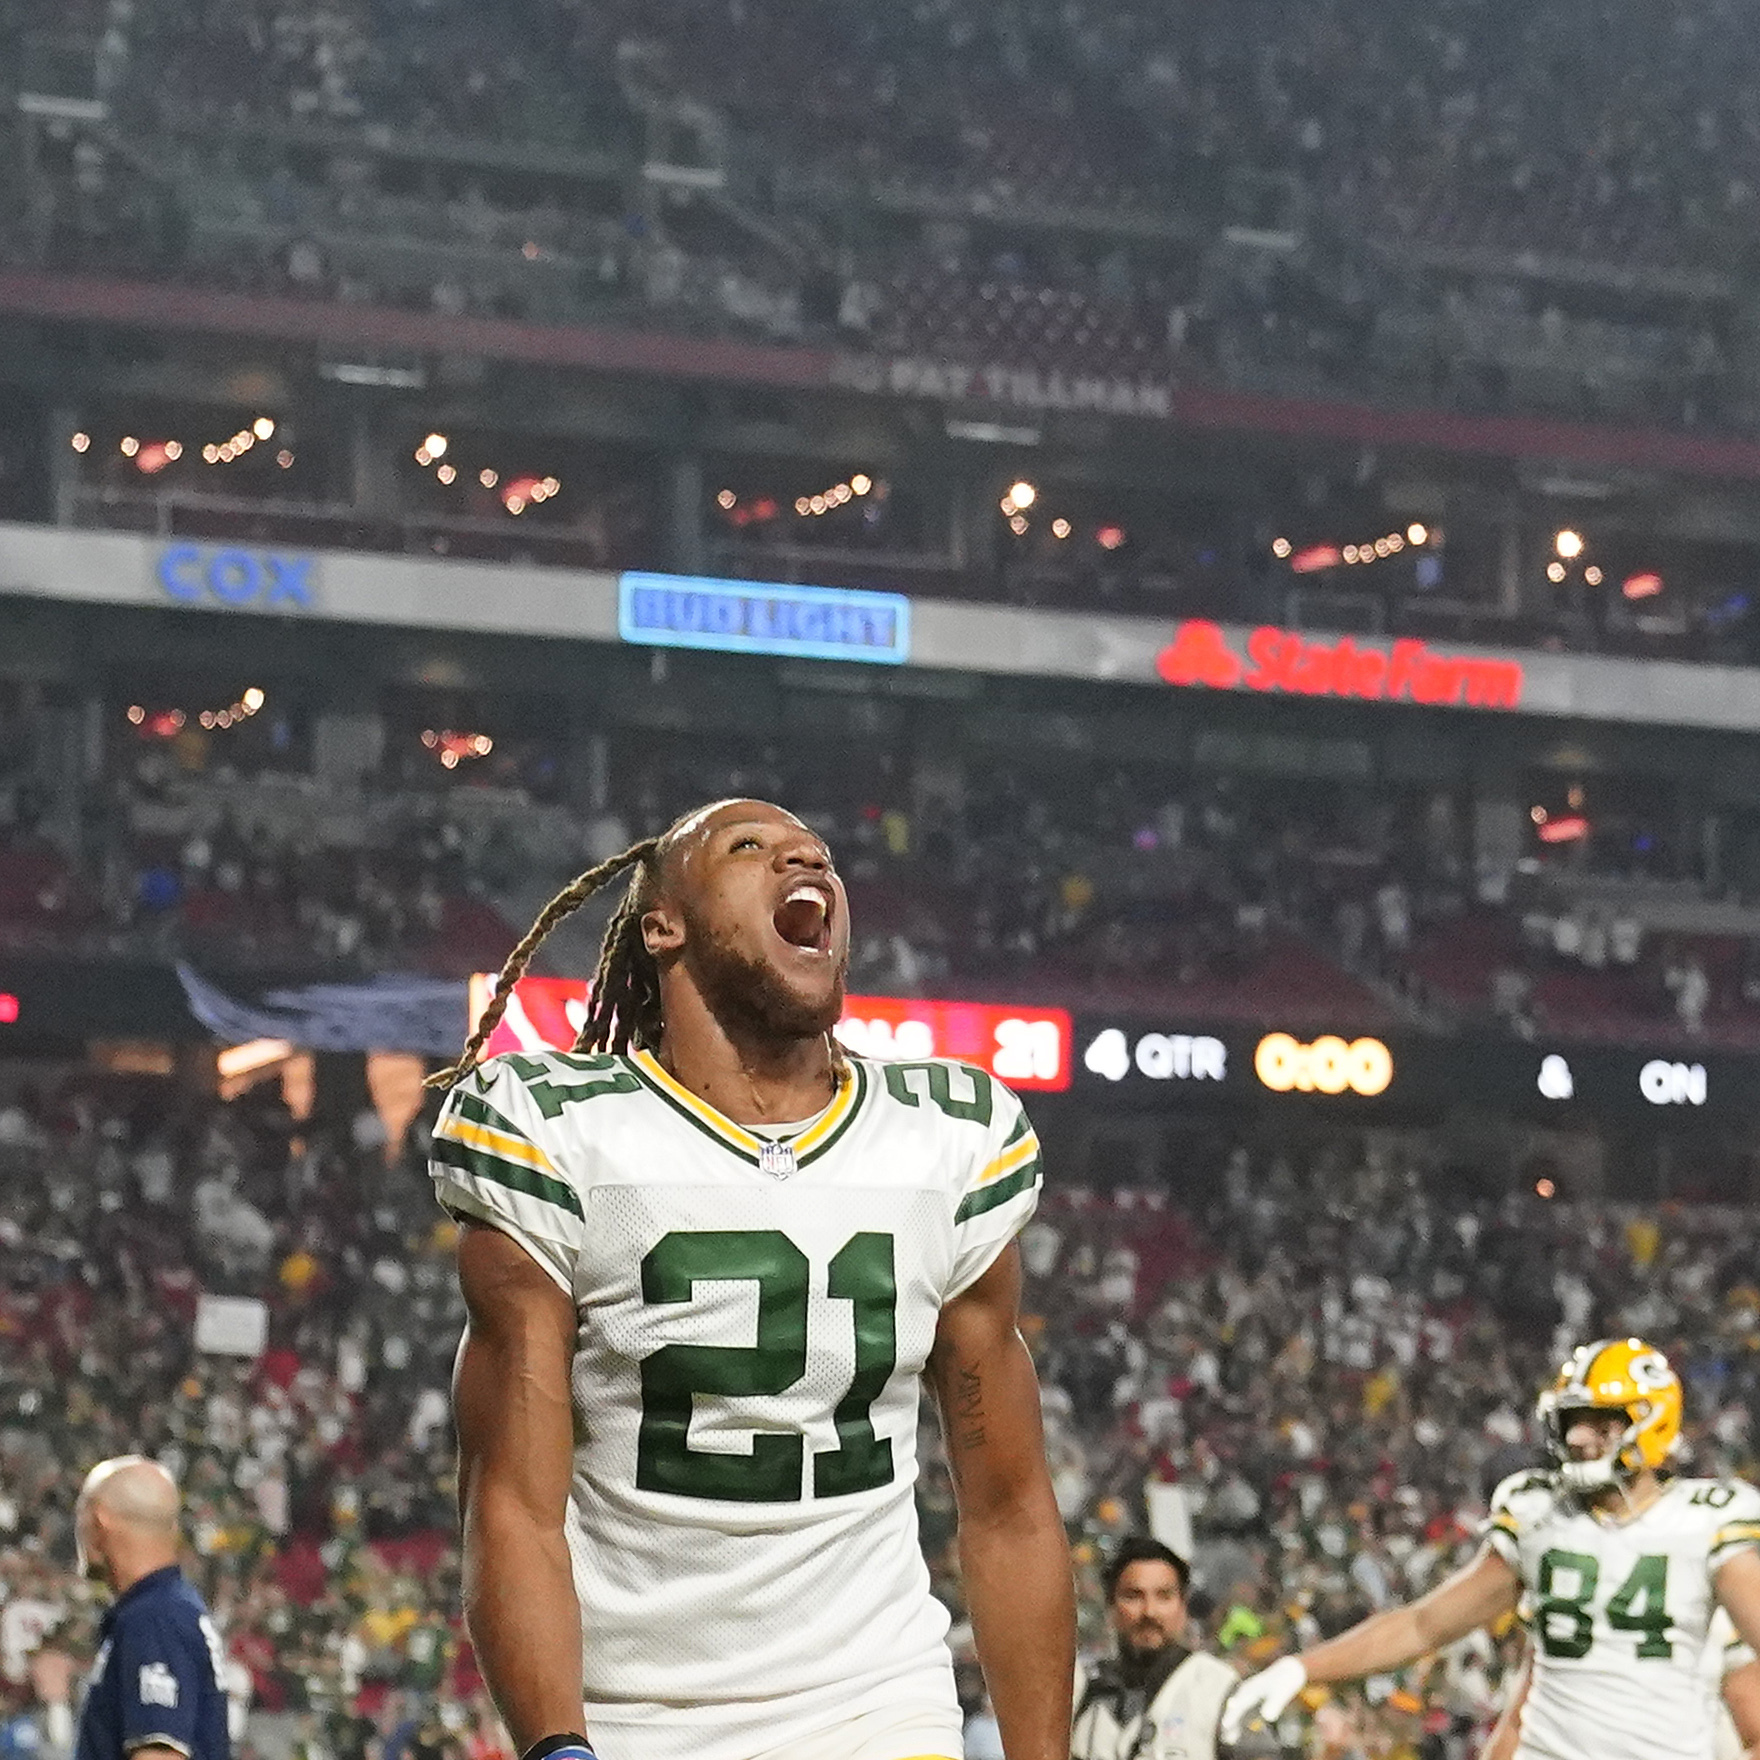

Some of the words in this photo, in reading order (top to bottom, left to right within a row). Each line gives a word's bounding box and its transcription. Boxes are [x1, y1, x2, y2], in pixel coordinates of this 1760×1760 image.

[155, 540, 314, 607] COX
[992, 1018, 1060, 1080] 21
[1084, 1028, 1130, 1082] 4
[1135, 1031, 1228, 1083] QTR
[1254, 1031, 1394, 1097] 0:00
[636, 1230, 897, 1502] 21
[1537, 1548, 1675, 1660] 84
